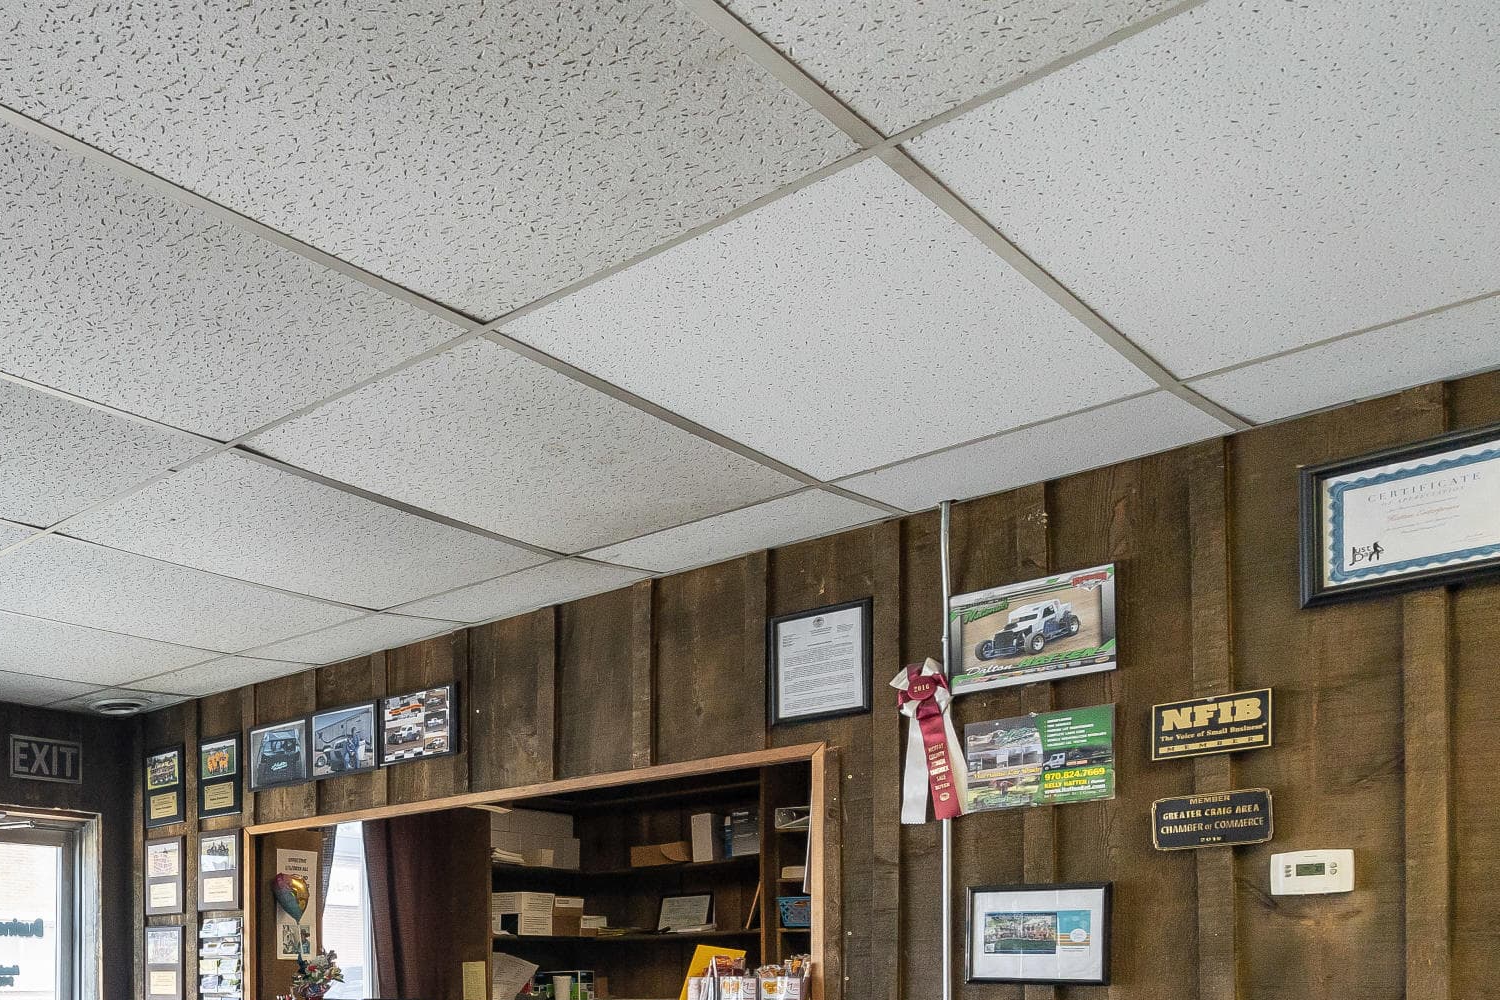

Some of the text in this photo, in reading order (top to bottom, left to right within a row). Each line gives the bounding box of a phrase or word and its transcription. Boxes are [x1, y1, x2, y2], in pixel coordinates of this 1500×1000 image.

[1367, 472, 1482, 502] CERTIFICATE
[966, 664, 1013, 676] Dalton
[913, 684, 930, 692] 2016
[1161, 697, 1262, 732] NFIB
[1207, 728, 1228, 736] Small
[14, 741, 78, 777] EXIT
[1190, 795, 1230, 805] MEMBER
[1163, 803, 1260, 821] GREATER CRAIG AREA
[1160, 823, 1204, 834] CHAMBER
[1214, 817, 1265, 829] COMMERCE
